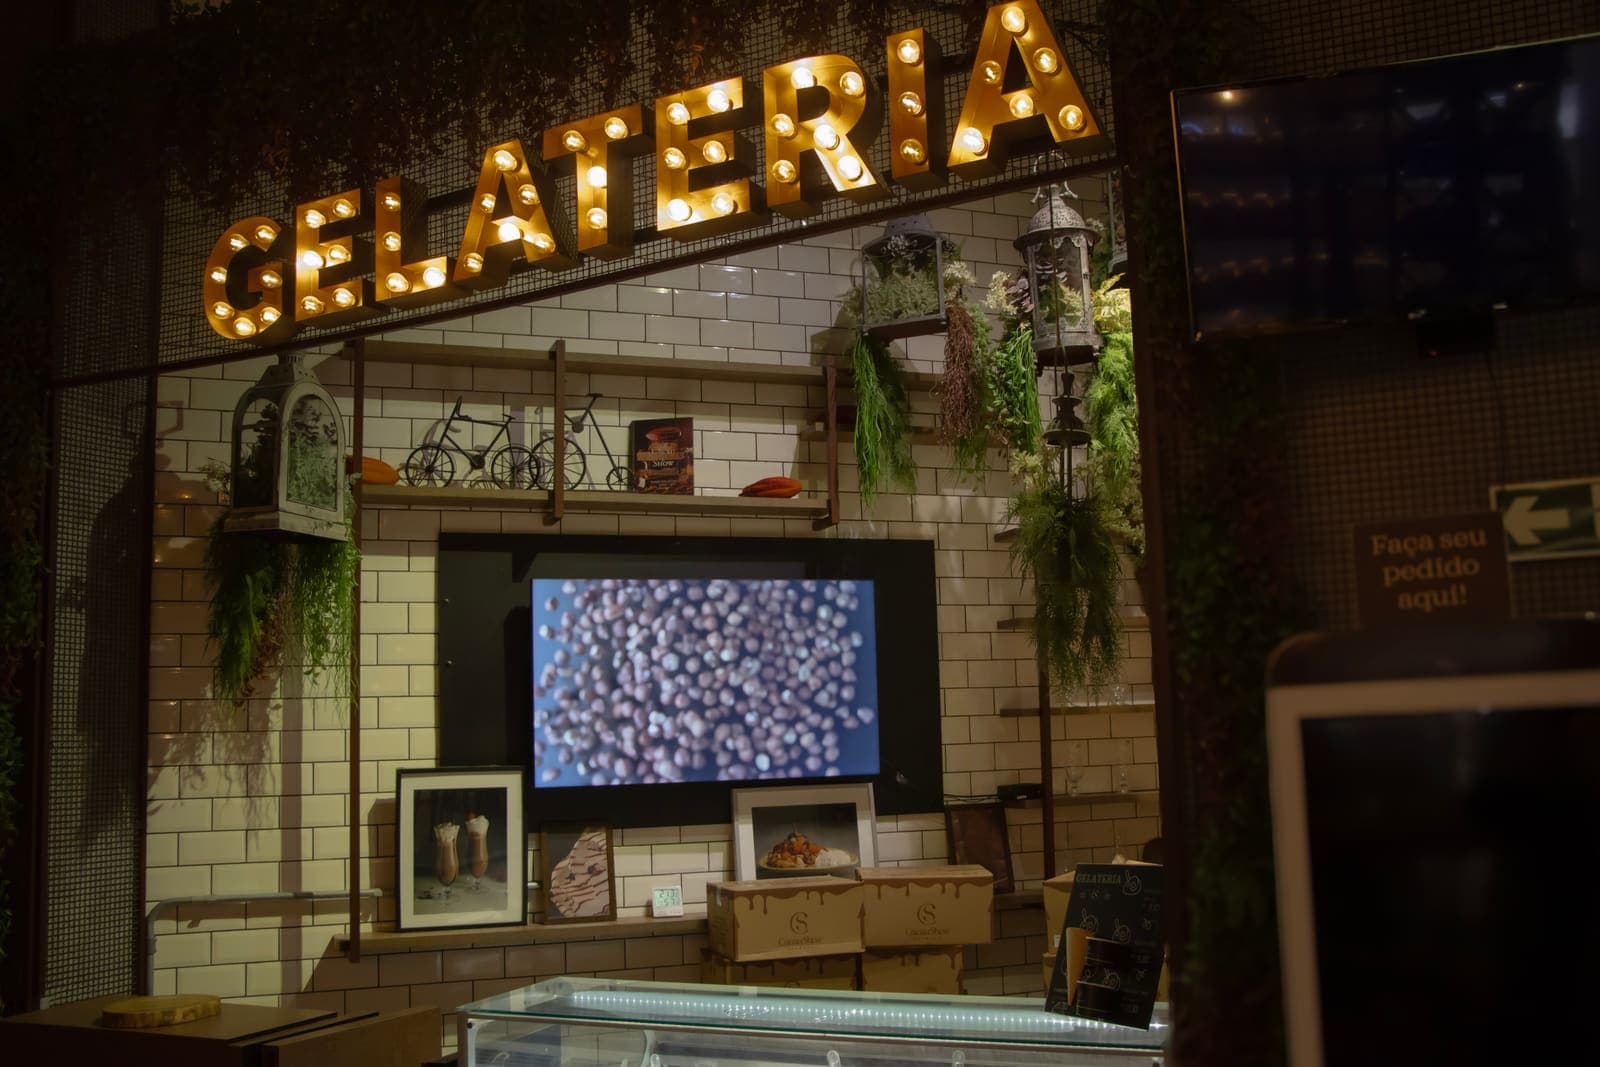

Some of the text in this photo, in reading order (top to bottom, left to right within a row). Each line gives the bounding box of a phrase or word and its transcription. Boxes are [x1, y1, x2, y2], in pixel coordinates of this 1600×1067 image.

[203, 0, 1102, 340] GELATERIA
[1371, 529, 1487, 558] Faça seu
[1383, 556, 1480, 588] pedido
[1398, 584, 1467, 613] aqui!
